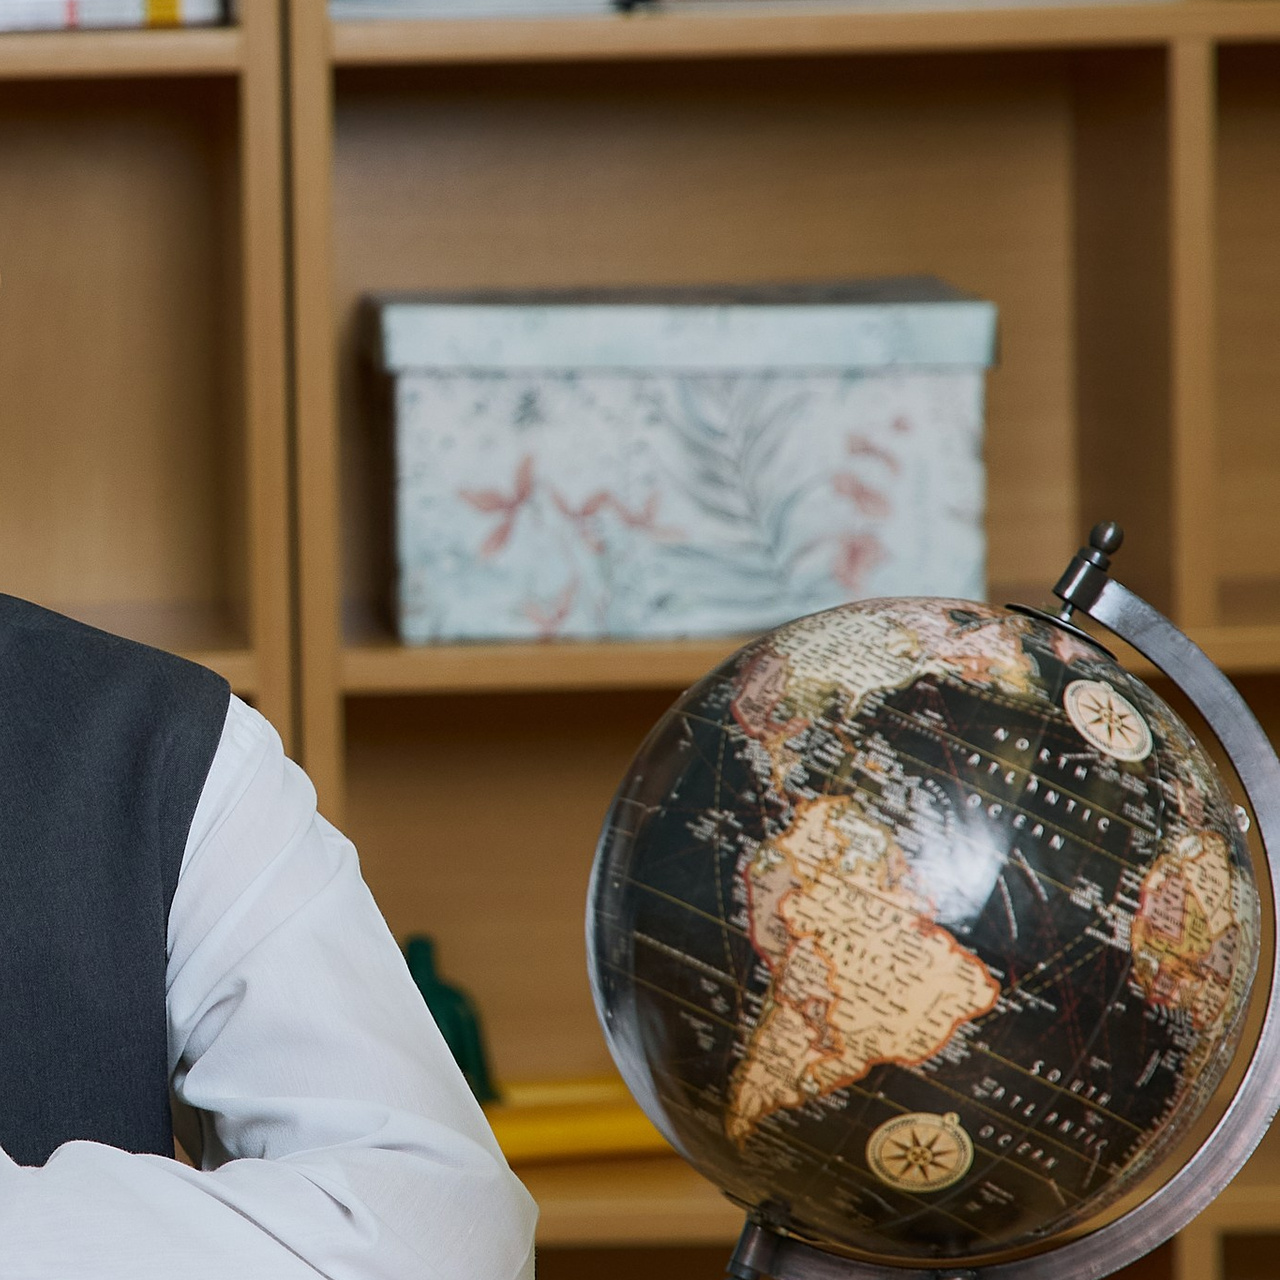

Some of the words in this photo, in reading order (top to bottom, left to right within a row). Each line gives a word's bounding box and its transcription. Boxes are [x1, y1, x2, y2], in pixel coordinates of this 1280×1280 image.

[993, 727, 1088, 781] NORTH
[967, 753, 1110, 832] ATLANTIC
[966, 793, 1065, 851] OCEAN
[1029, 1059, 1112, 1107] SOUTH
[978, 1124, 1059, 1169] OCEAN
[991, 1086, 1109, 1151] ATLANTIC
